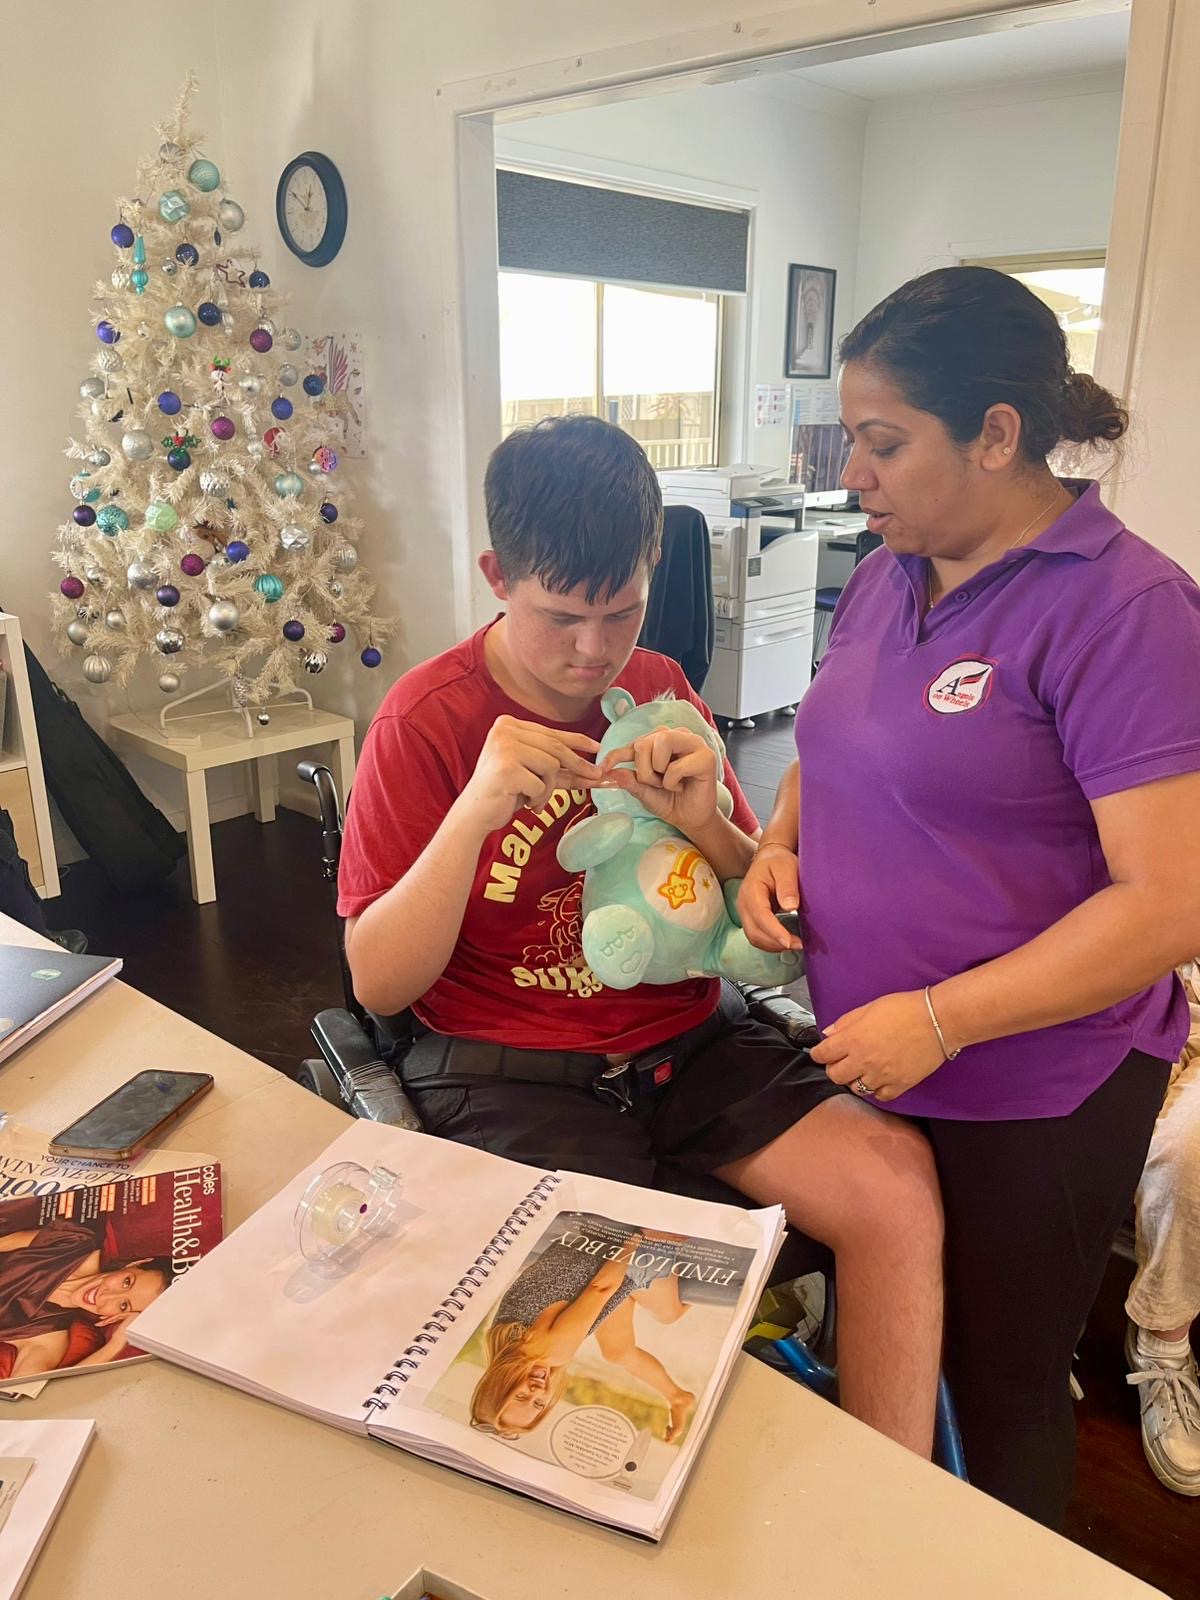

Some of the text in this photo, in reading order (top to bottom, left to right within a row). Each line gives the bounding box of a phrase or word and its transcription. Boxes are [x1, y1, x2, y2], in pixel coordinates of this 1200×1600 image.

[41, 1155, 69, 1165] YOUR
[71, 1160, 113, 1169] CHANCE
[203, 1165, 219, 1196] coles
[550, 1231, 738, 1286] FIND LOVE BUY
